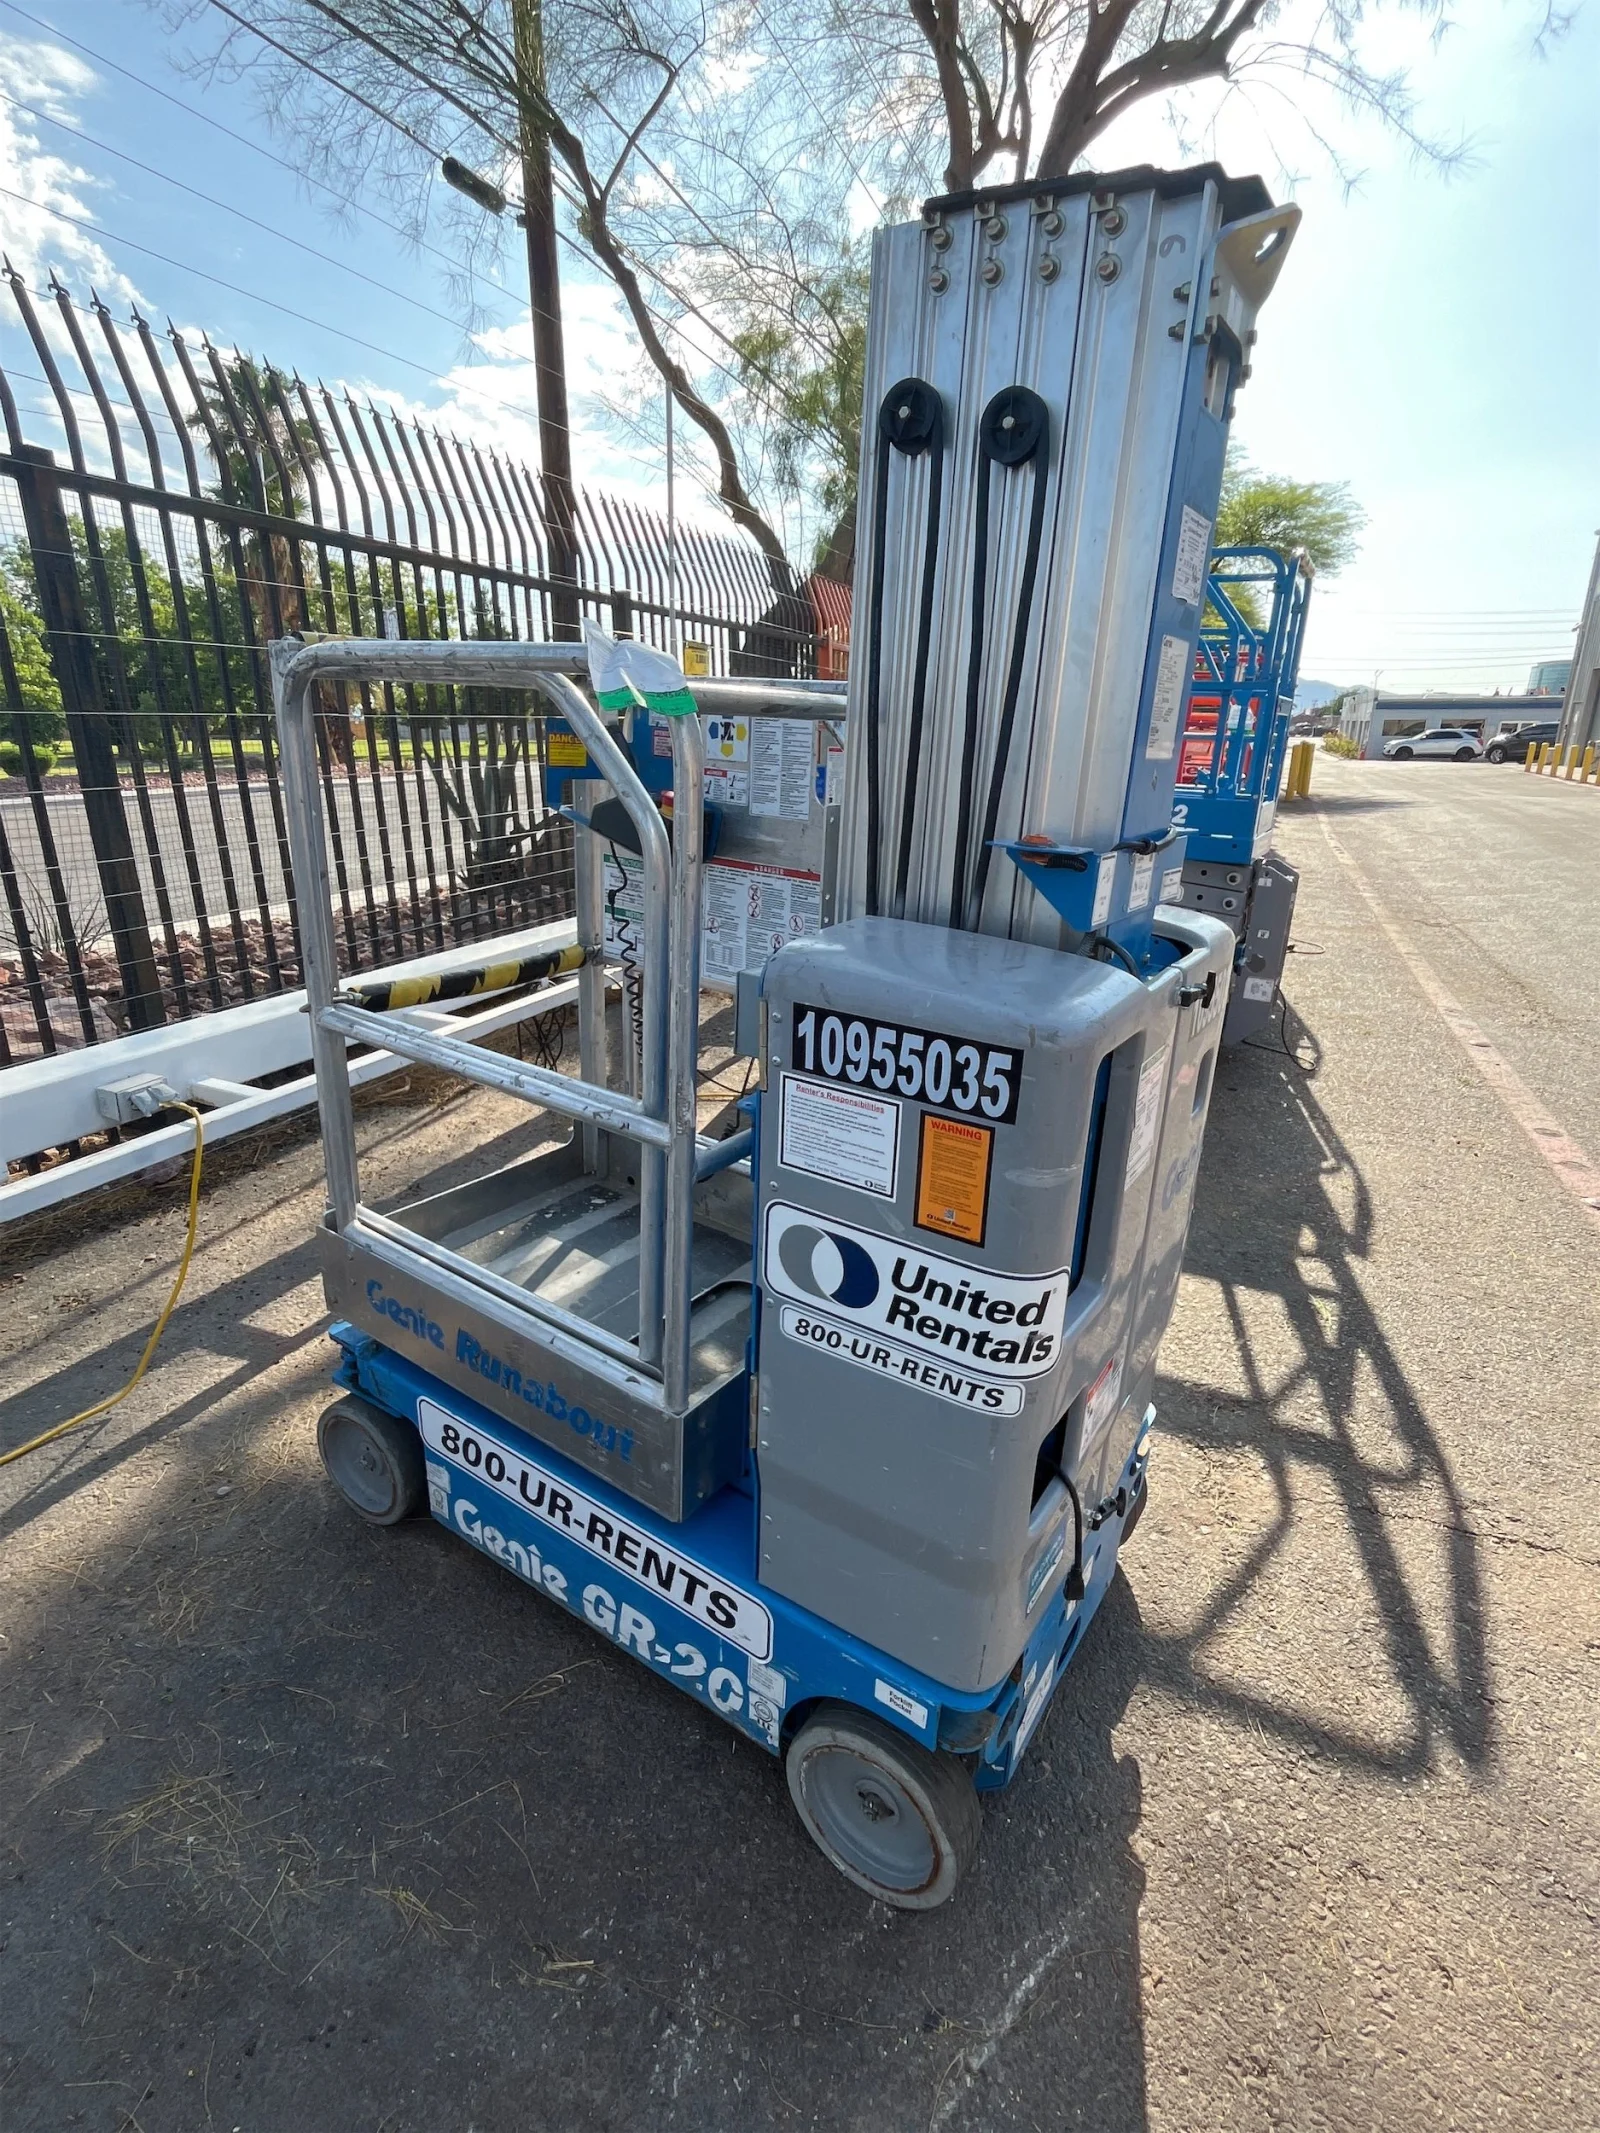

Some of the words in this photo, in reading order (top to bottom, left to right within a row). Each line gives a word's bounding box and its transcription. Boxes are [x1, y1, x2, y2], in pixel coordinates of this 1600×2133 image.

[796, 1084, 825, 1098] Renter's
[827, 1093, 885, 1114] Responsibilities
[798, 1011, 1013, 1117] 10955035
[931, 1121, 982, 1140] WARNING
[891, 1257, 1052, 1326] United
[795, 1318, 1005, 1408] 800-UR-RENTS
[885, 1294, 1053, 1365] Rentals
[366, 1279, 444, 1350] Genie
[457, 1327, 635, 1464] Runabout
[441, 1424, 738, 1629] 800-UR-RENTS
[454, 1499, 568, 1602] Genie
[890, 1691, 913, 1709] Forklift
[890, 1697, 912, 1715] Pocket
